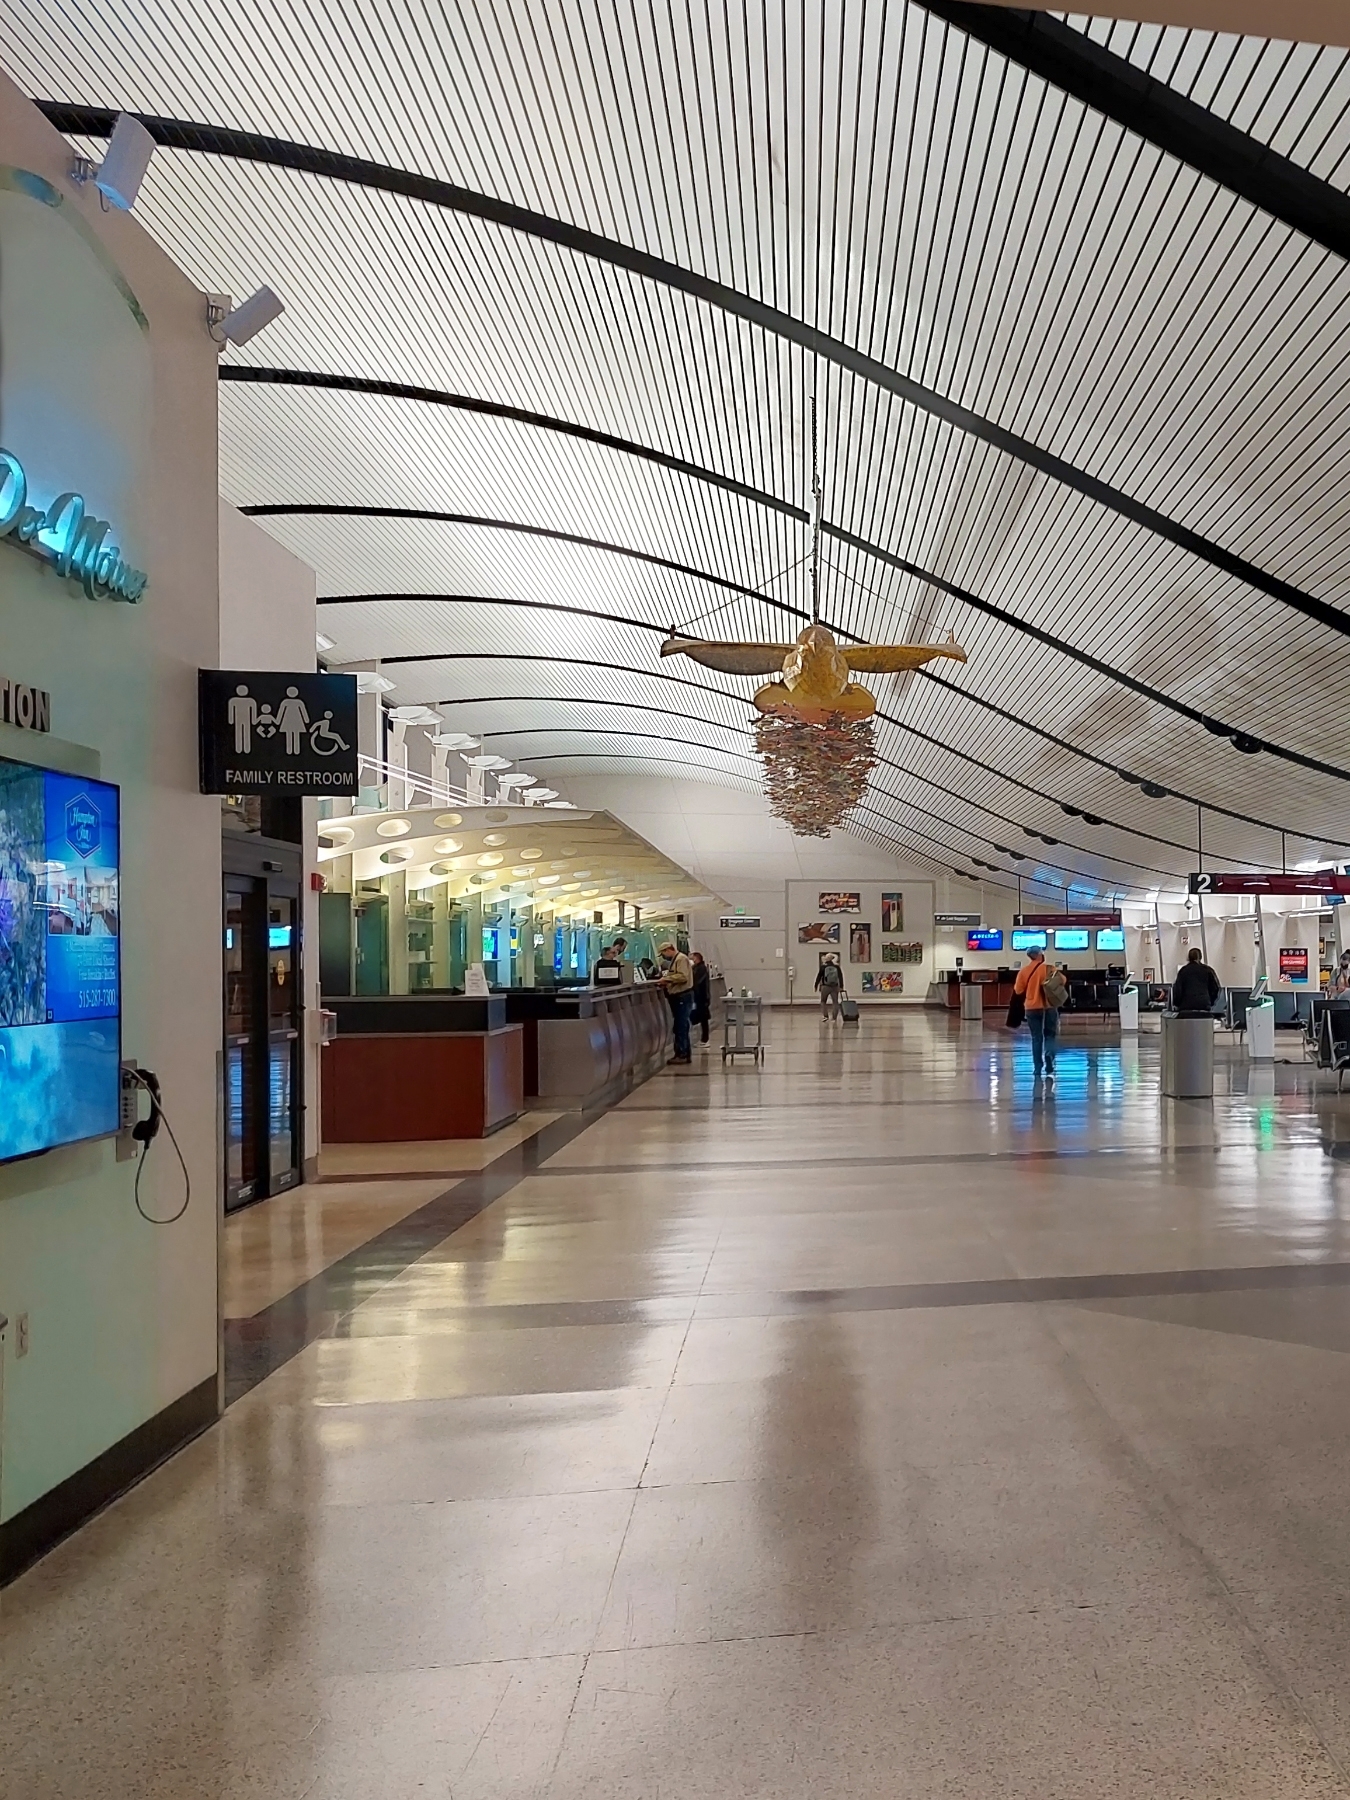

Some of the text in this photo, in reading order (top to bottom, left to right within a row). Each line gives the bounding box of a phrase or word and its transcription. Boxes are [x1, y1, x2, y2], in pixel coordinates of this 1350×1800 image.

[225, 769, 354, 786] FAMILY RESTROOM
[1197, 873, 1212, 893] 2
[1016, 914, 1024, 926] 1
